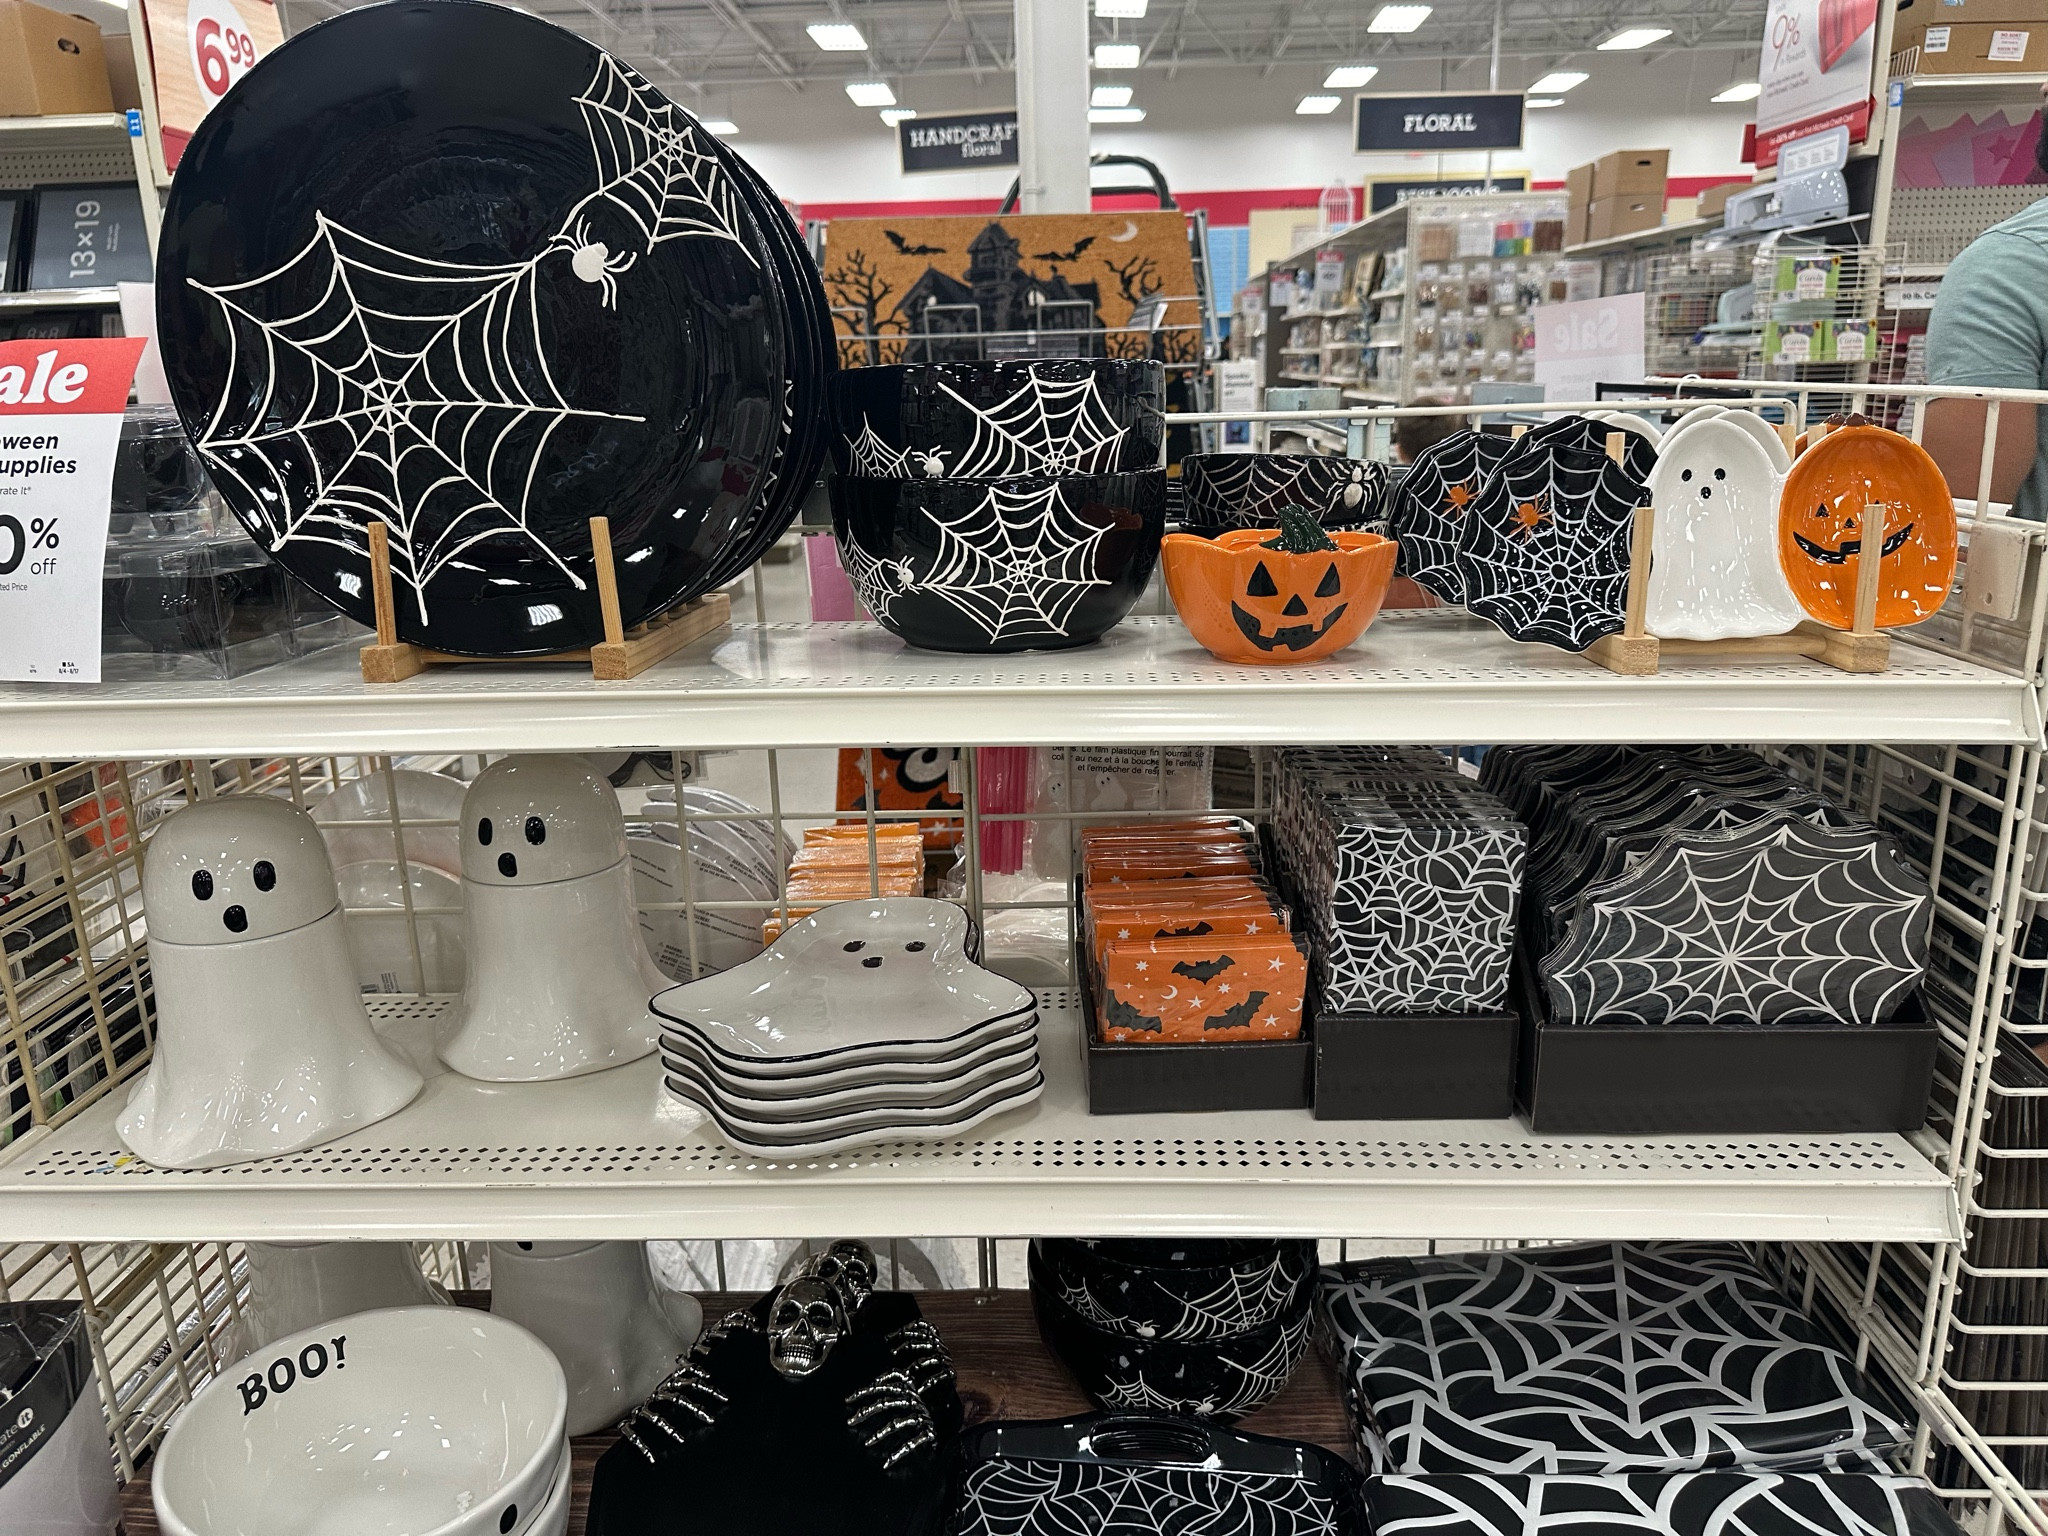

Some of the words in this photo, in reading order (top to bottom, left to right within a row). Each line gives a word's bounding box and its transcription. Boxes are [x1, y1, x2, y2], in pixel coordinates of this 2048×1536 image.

[1403, 114, 1478, 133] FLORAL
[909, 121, 1019, 148] HANDCRAF
[961, 139, 1002, 158] floral
[0, 435, 59, 450] ween
[31, 558, 57, 575] off
[12, 582, 28, 591] Price
[1111, 747, 1146, 756] plastique
[1087, 765, 1129, 774] l'empêcher
[1114, 756, 1120, 764] à
[1131, 758, 1160, 766] bouche
[236, 1335, 348, 1415] BOO!
[2, 1423, 46, 1468] GONFLABLE
